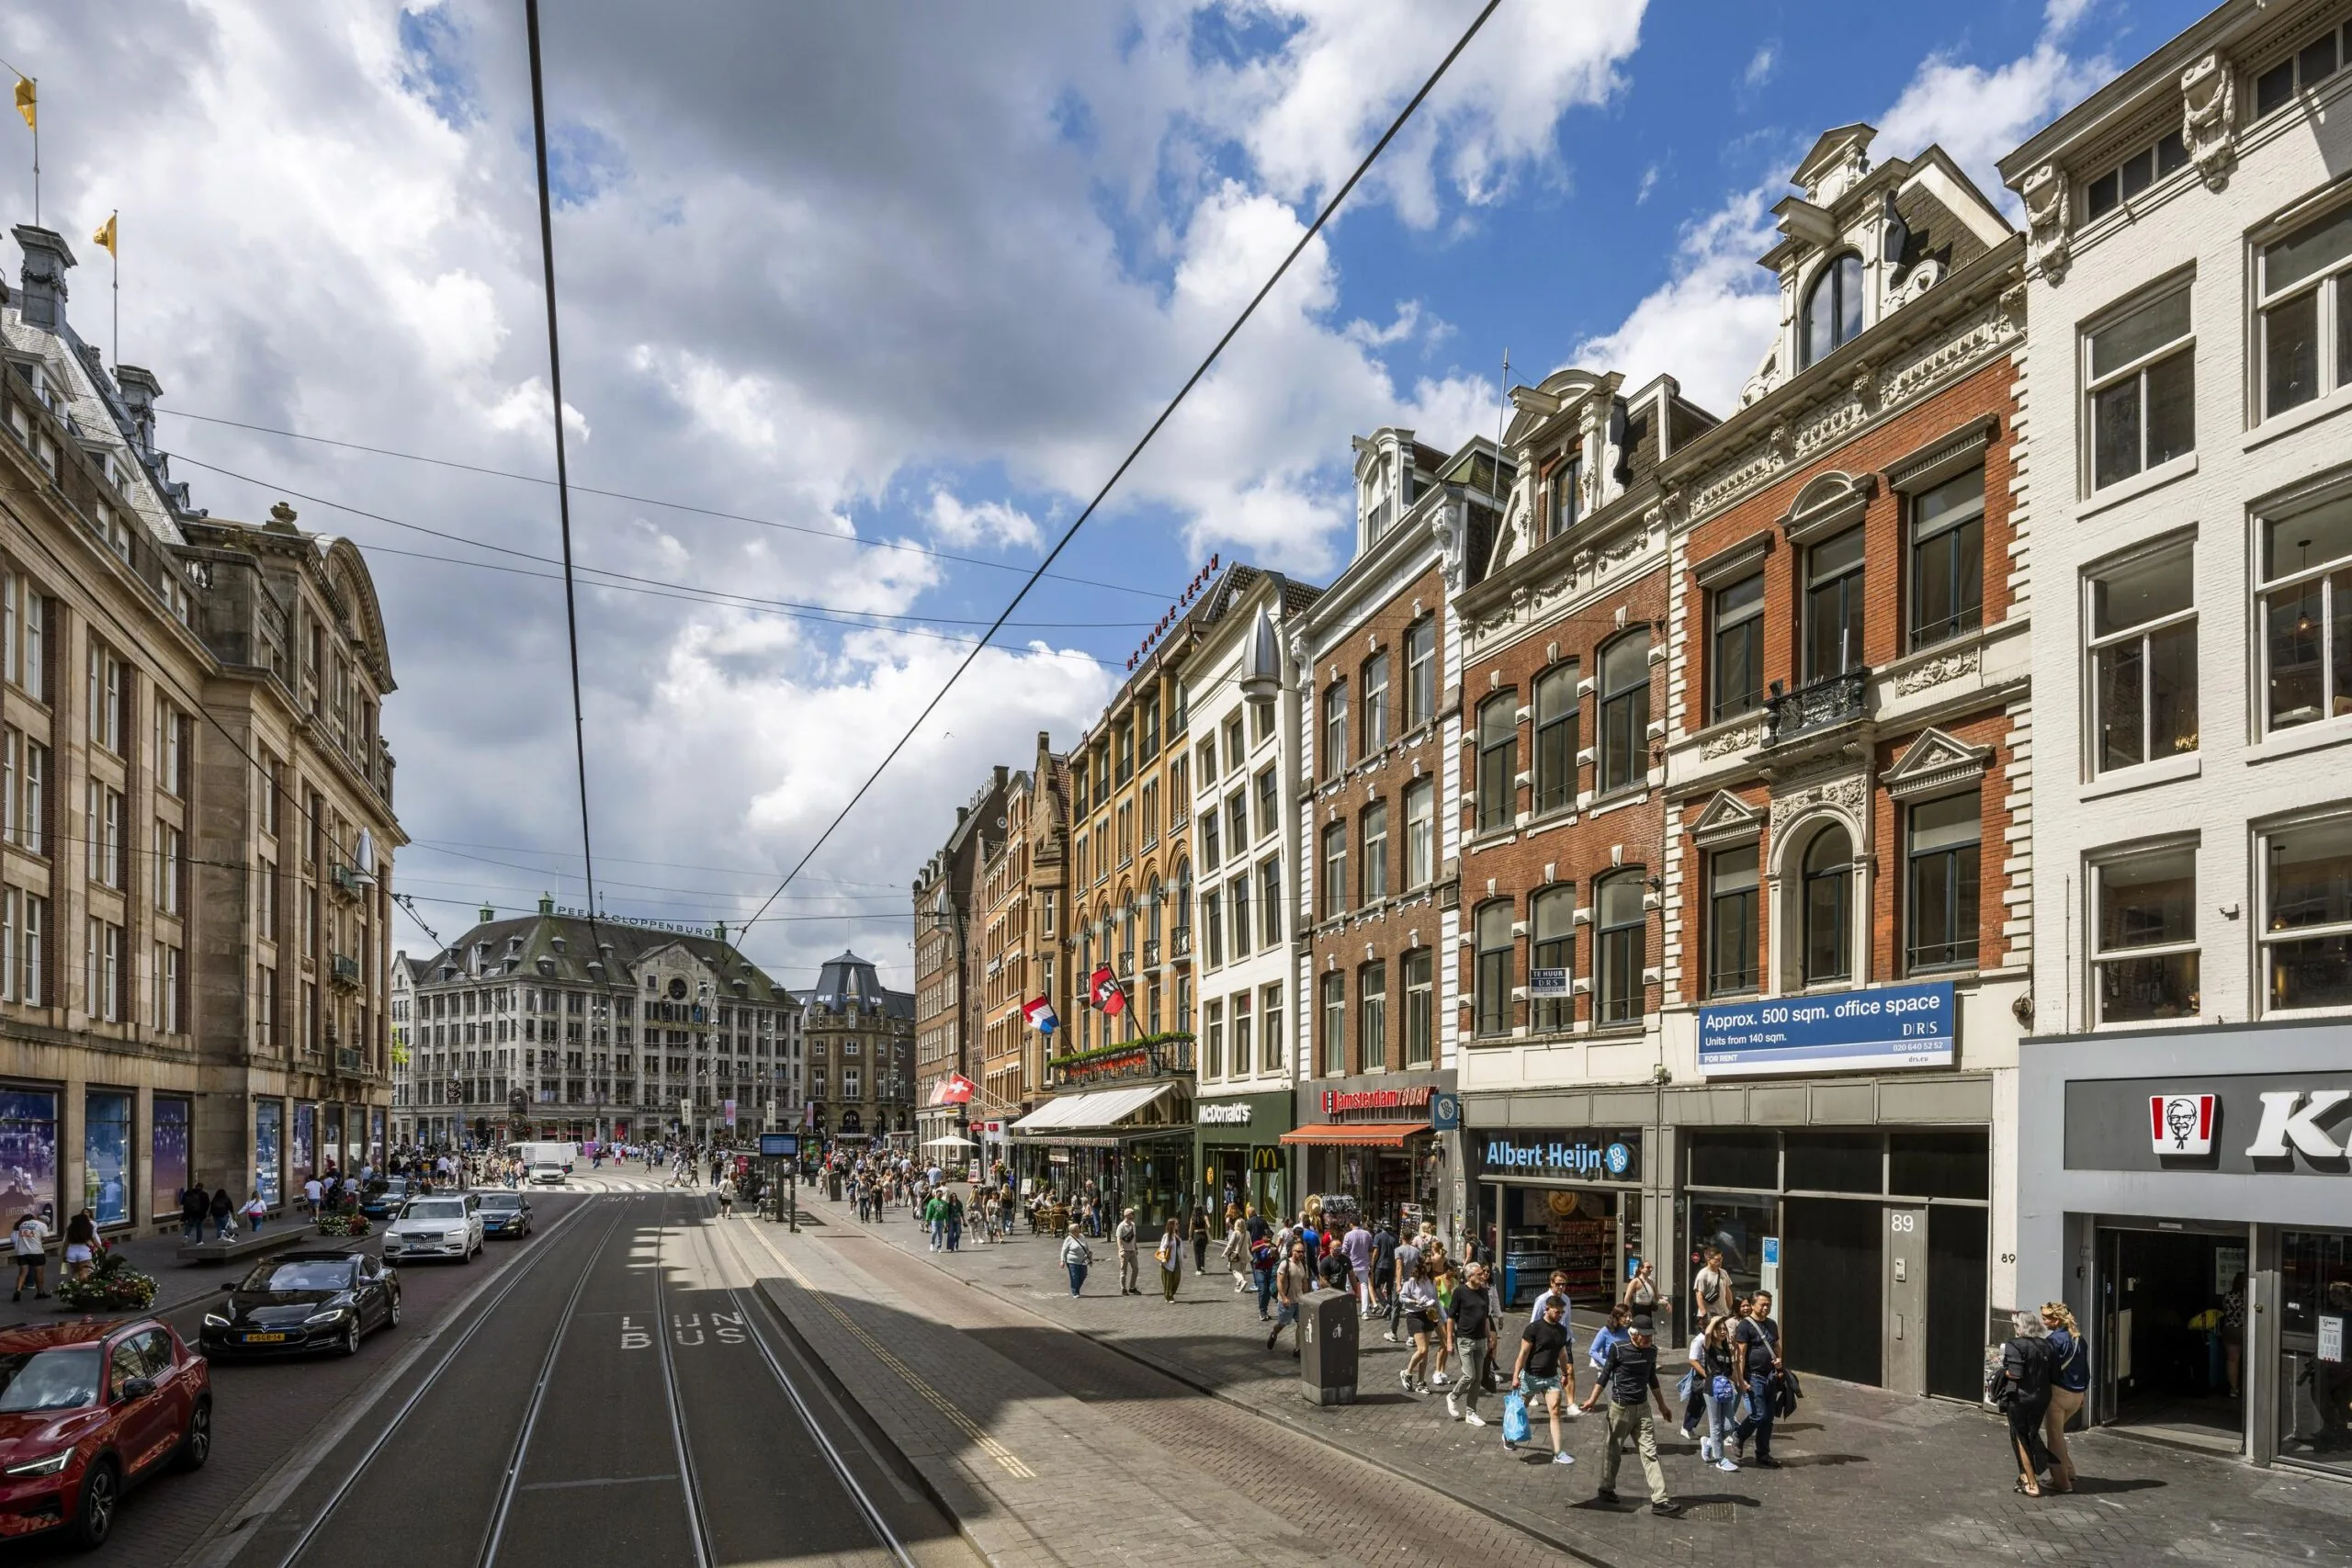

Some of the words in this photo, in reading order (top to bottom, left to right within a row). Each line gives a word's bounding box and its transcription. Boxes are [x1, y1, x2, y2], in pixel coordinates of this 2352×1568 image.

[611, 914, 713, 937] CLOPPENBURG
[1705, 1013, 1758, 1032] Approx.
[1762, 1007, 1789, 1024] 500
[1792, 1006, 1830, 1024] sqm.
[1835, 999, 1881, 1018] office
[1885, 995, 1940, 1016] space
[1705, 1036, 1726, 1046] Units
[1727, 1035, 1747, 1044] from
[1748, 1032, 1764, 1043] 140
[1765, 1033, 1787, 1044] sqm.
[1893, 1043, 1906, 1052] 020
[1907, 1043, 1922, 1051] 640
[1923, 1042, 1933, 1050] 52
[1933, 1042, 1943, 1050] 52
[1720, 1054, 1738, 1062] RENT
[1198, 1102, 1251, 1123] McDonald's
[1487, 1141, 1544, 1167] Albert
[1549, 1143, 1600, 1174] Heijn
[1610, 1147, 1621, 1158] to
[1613, 1156, 1625, 1172] go
[1892, 1213, 1914, 1232] 89
[2001, 1253, 2016, 1264] 89
